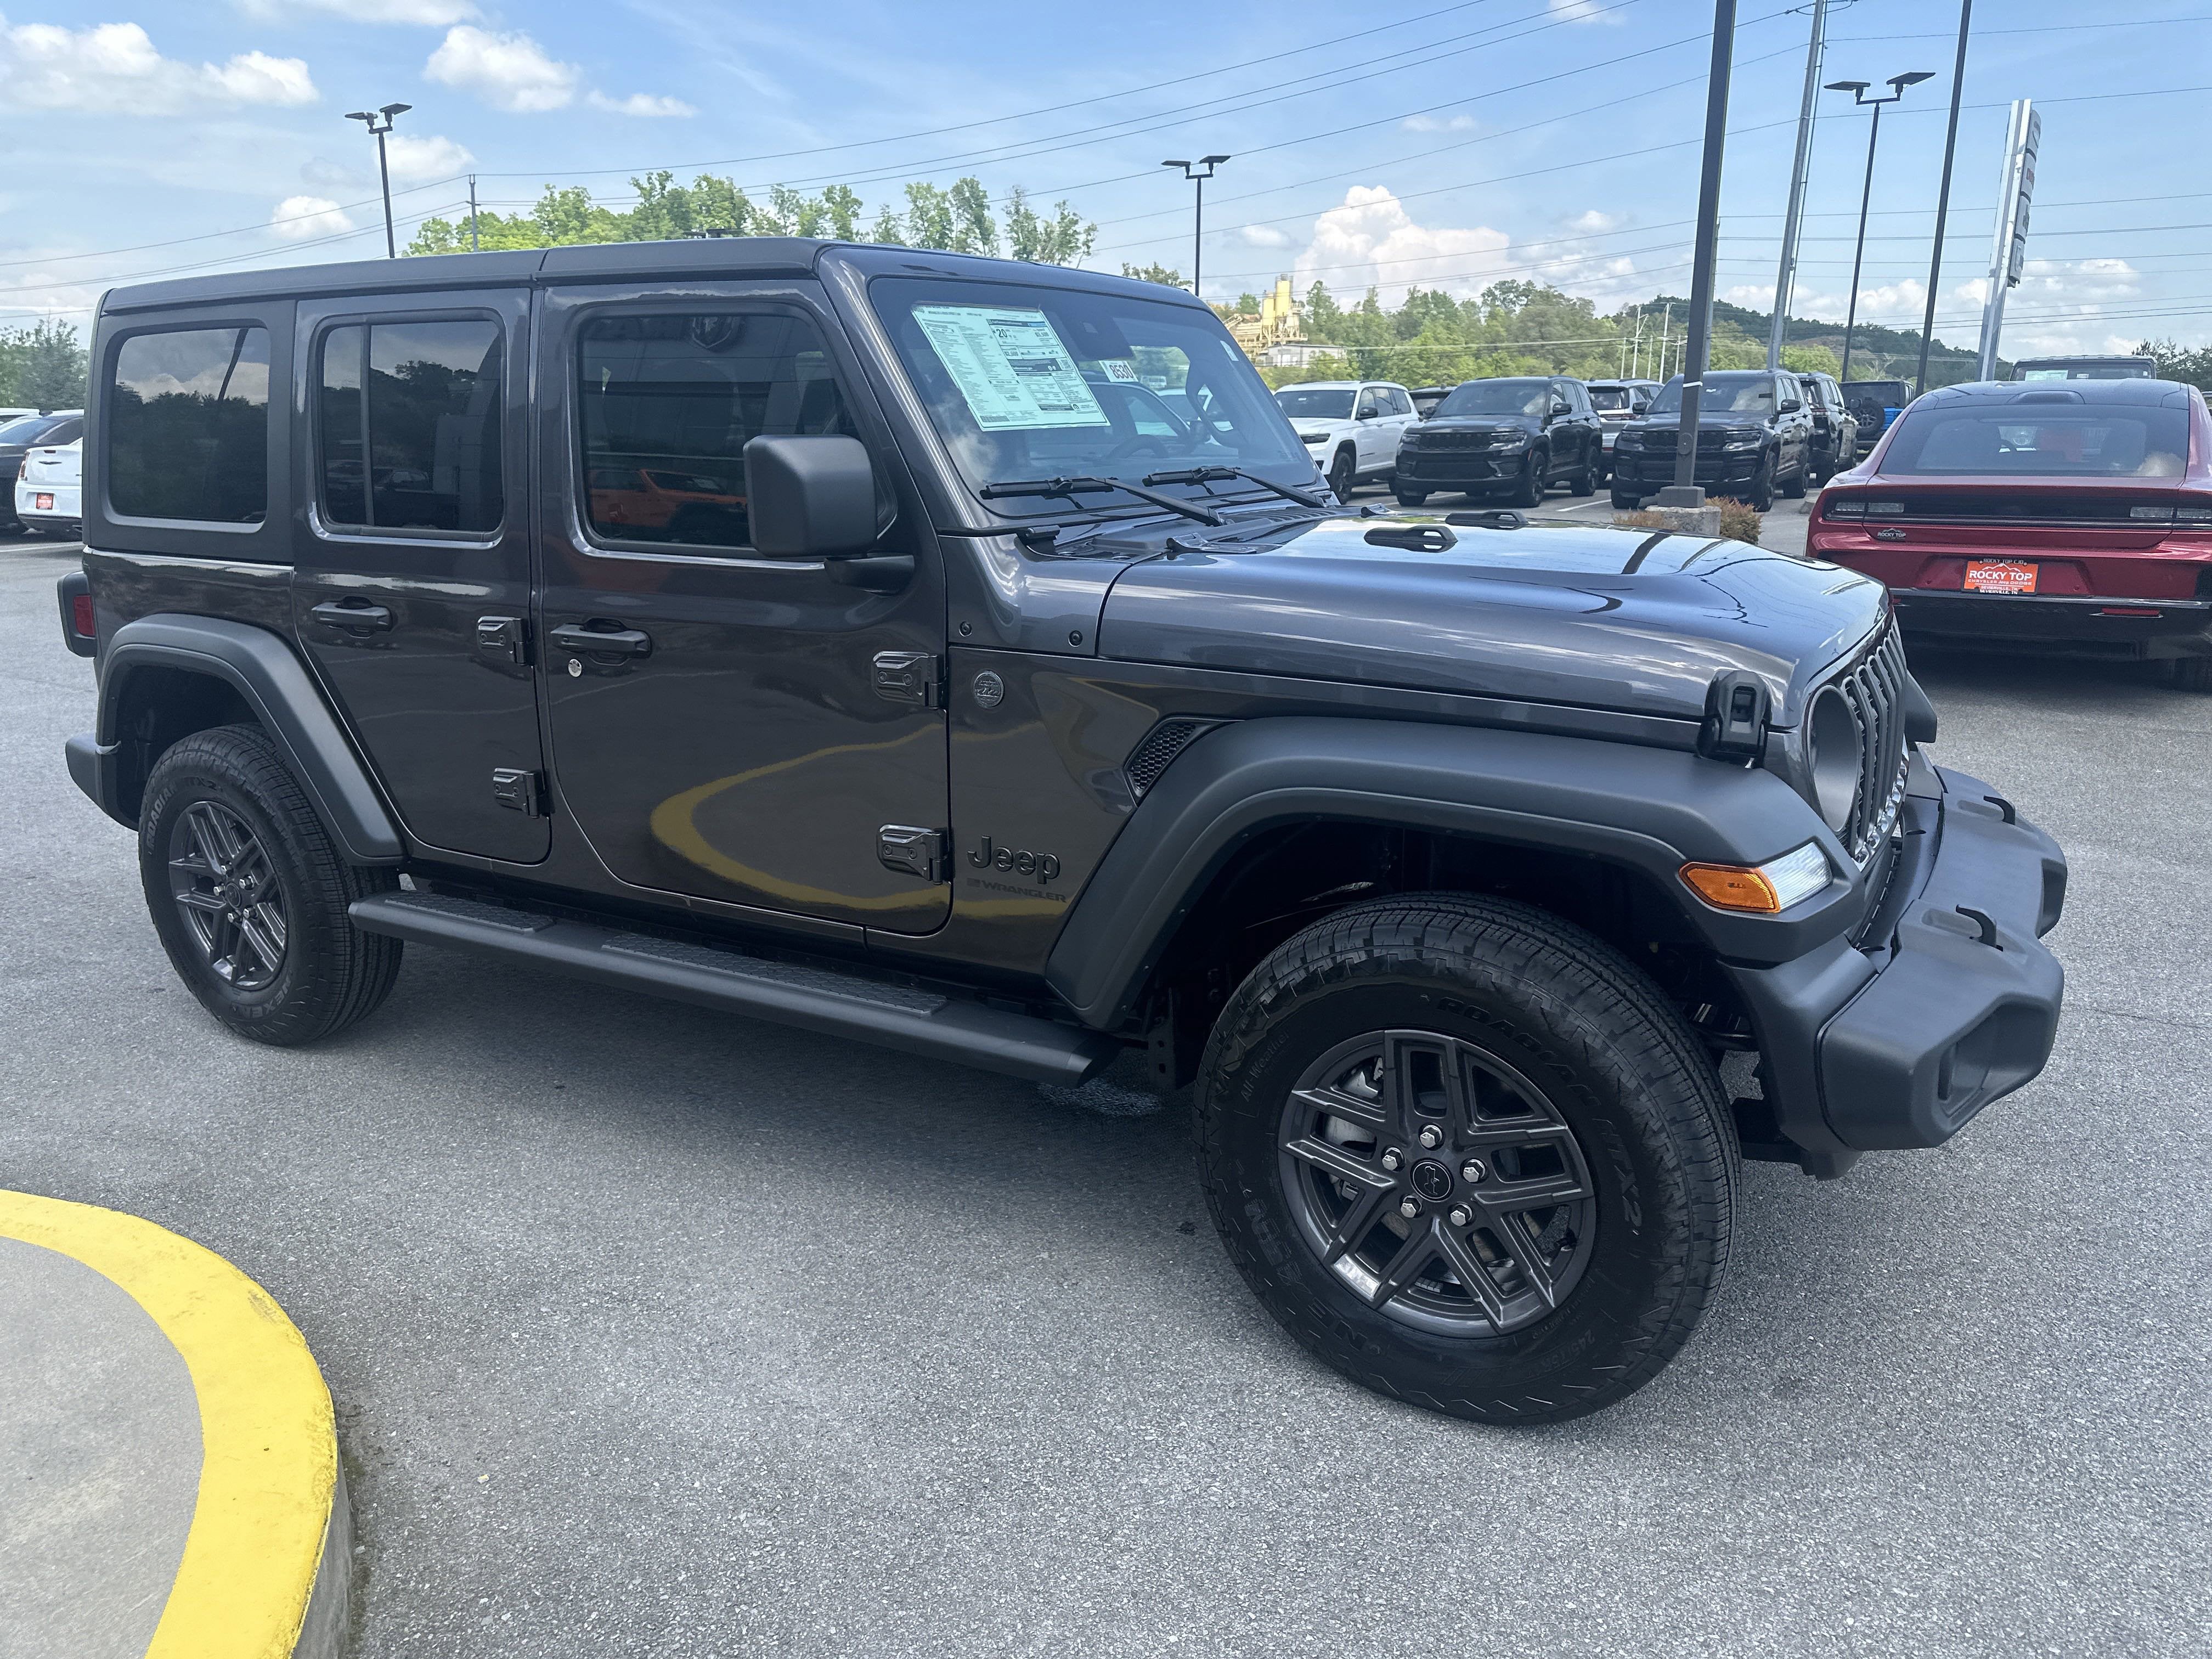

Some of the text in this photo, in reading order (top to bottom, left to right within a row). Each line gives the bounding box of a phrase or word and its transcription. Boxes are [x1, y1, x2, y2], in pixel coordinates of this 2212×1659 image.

[996, 329, 1008, 338] 20
[1109, 364, 1134, 379] 8530
[1969, 571, 2033, 581] ROCKY TOP
[967, 835, 1060, 885] Jeep
[981, 880, 1066, 902] WRANGLER
